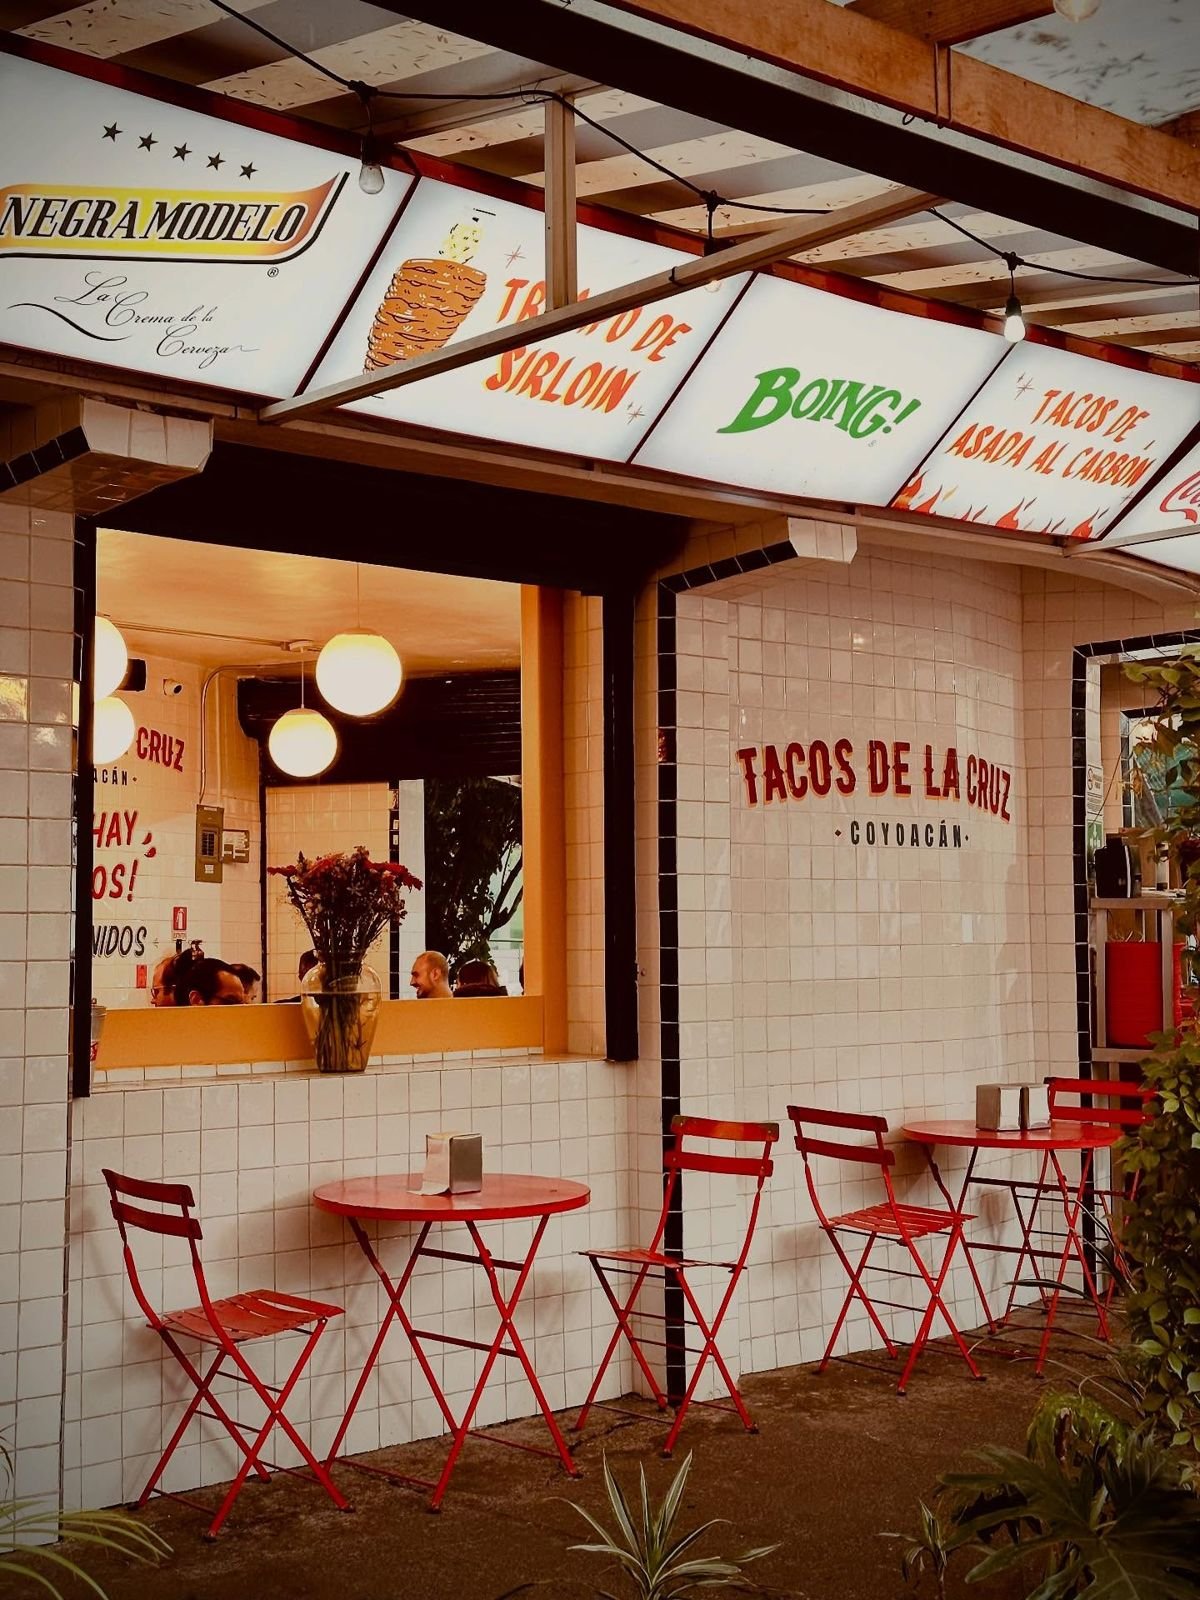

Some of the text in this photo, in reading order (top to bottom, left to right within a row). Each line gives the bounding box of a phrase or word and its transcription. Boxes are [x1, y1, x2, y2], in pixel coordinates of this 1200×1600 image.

[0, 197, 138, 239] NEGRA
[140, 200, 306, 242] MODELO
[54, 271, 128, 305] La
[105, 291, 175, 326] Crema
[180, 305, 204, 322] de
[496, 278, 693, 362] TRO DE
[156, 324, 259, 369] Cerveza
[484, 346, 641, 413] SIRLOIN
[716, 367, 921, 439] BOING!
[1030, 389, 1150, 443] TACOS DE
[945, 422, 1157, 488] ASADA AL CARBÓN
[136, 726, 185, 773] CRUZ
[736, 738, 1011, 823] TACOS DE LA CRUZ
[850, 820, 962, 848] COYOACÁN
